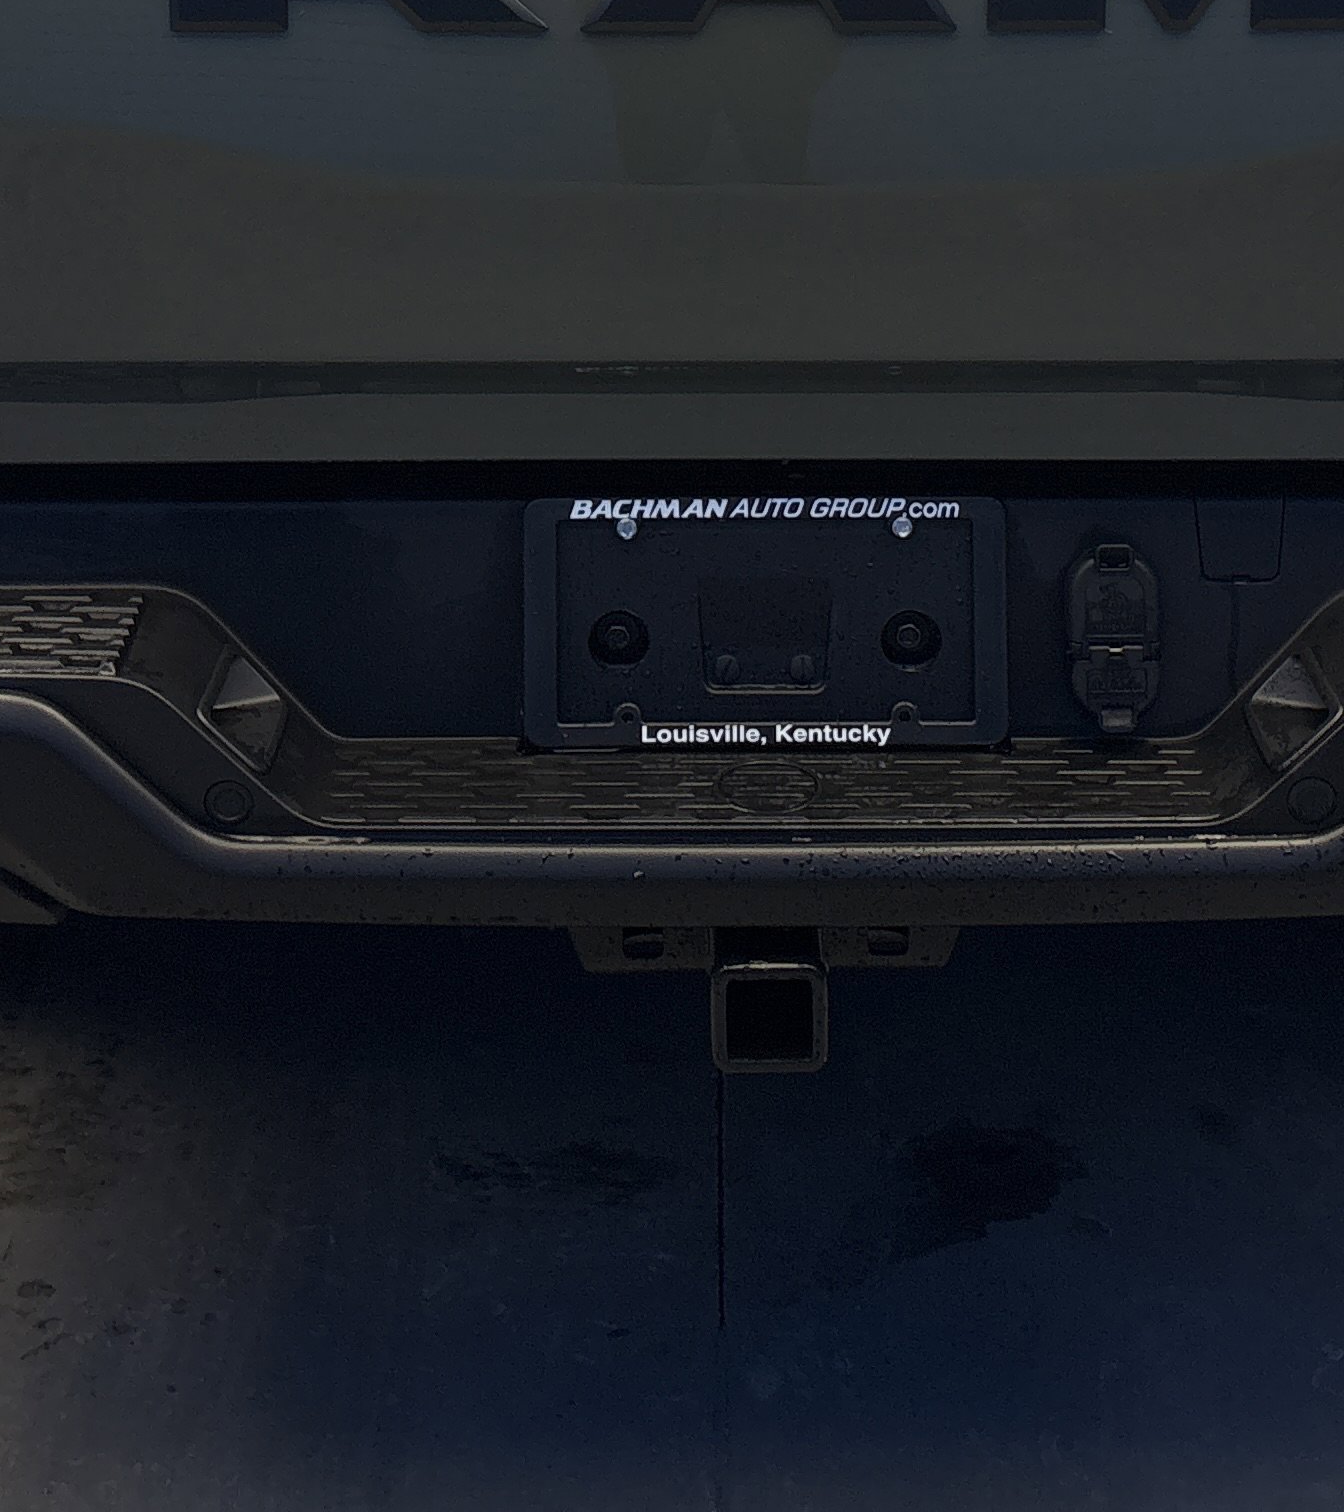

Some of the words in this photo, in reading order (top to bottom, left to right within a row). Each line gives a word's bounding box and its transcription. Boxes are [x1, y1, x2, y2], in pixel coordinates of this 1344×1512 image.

[569, 498, 729, 520] BACHMAN
[729, 497, 805, 519] AUTO
[640, 723, 768, 746] Louisville,
[775, 723, 892, 747] Kentucky
